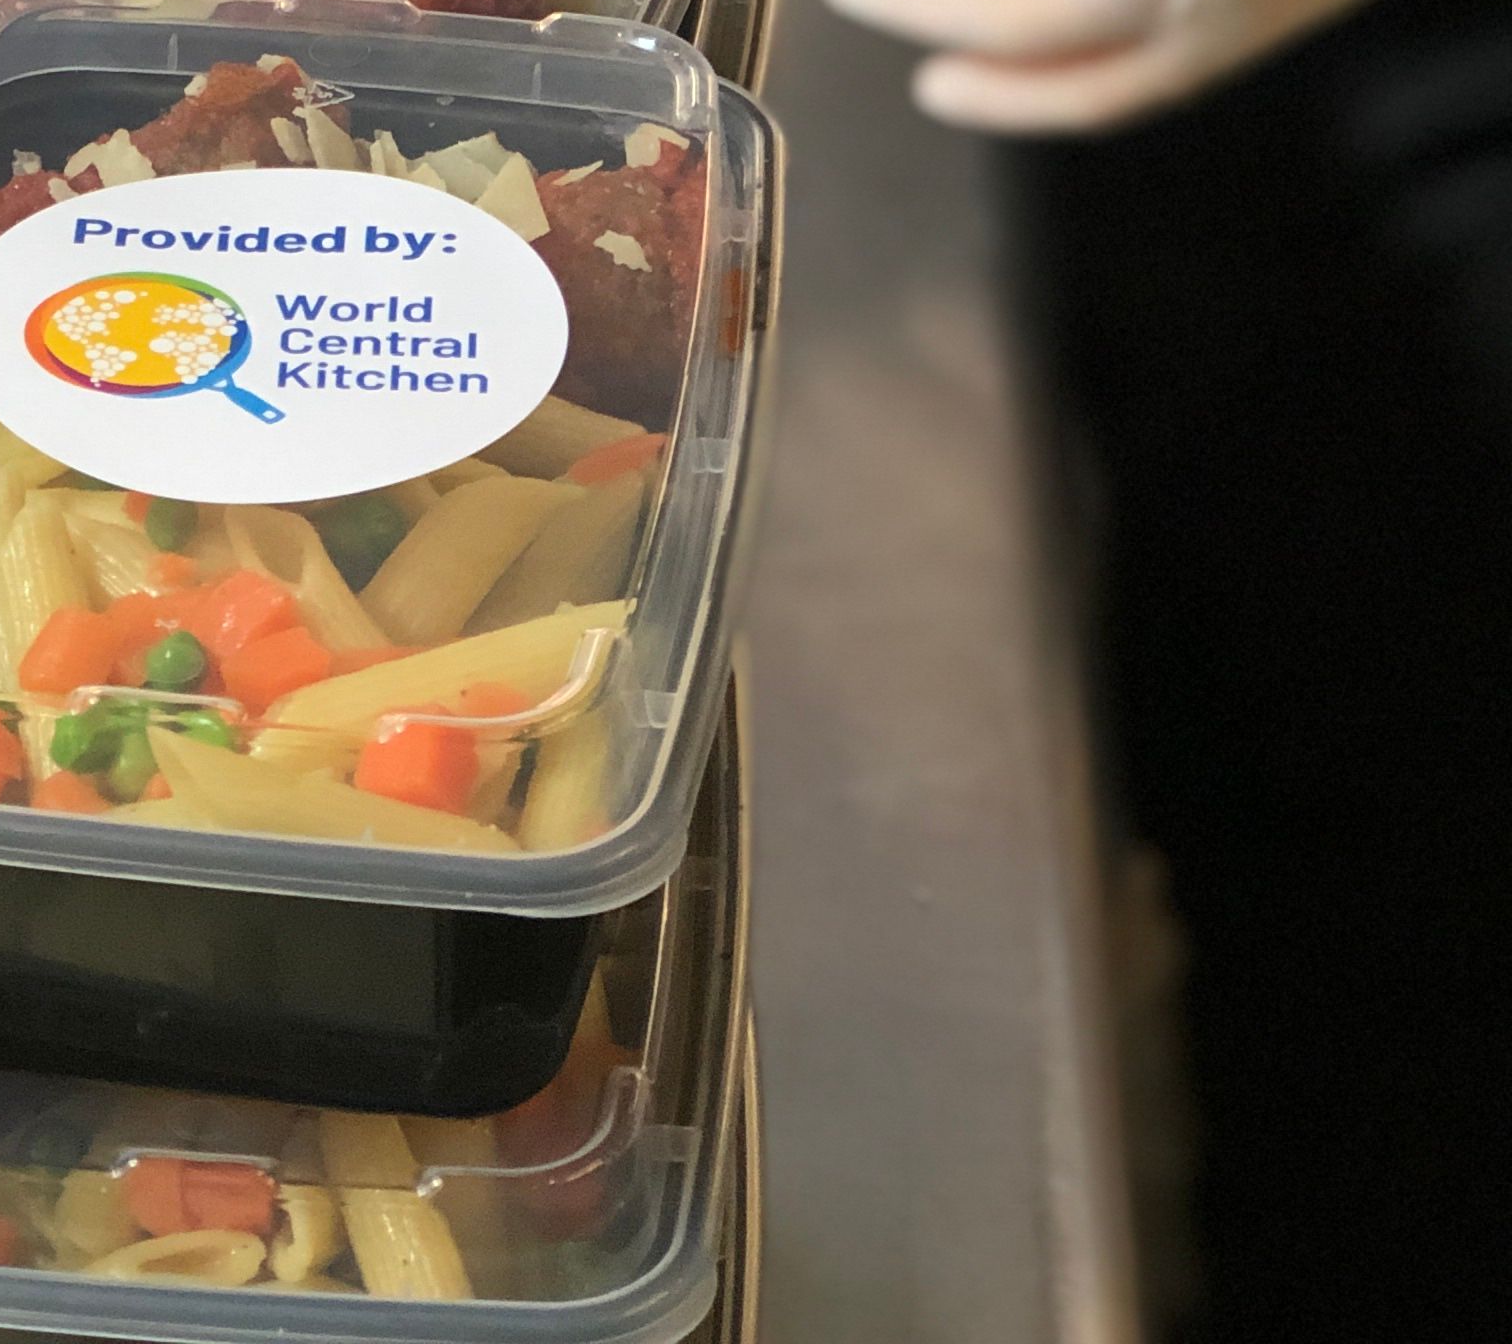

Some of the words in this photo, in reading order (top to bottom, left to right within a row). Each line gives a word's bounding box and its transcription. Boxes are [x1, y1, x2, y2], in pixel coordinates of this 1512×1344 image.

[73, 217, 348, 254] Provided
[362, 225, 457, 261] by:
[274, 292, 434, 323] World
[278, 326, 479, 360] Central
[276, 360, 490, 394] Kitchen
